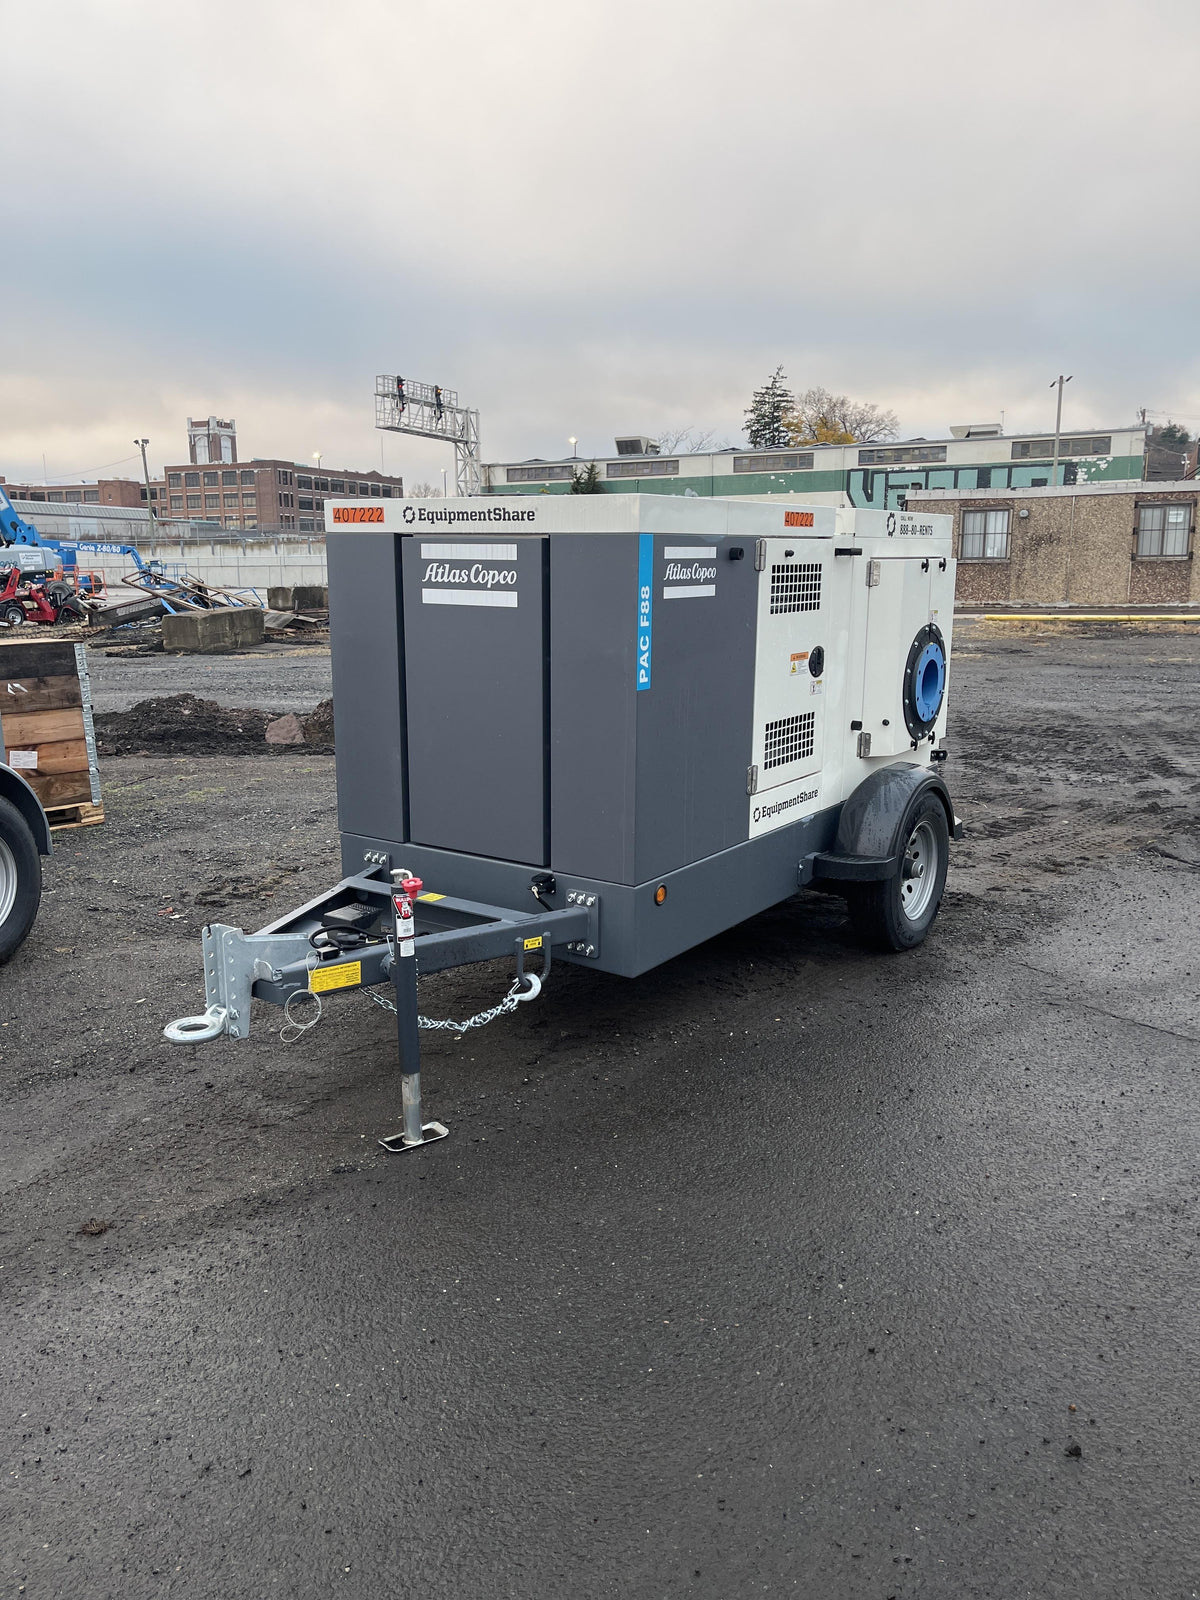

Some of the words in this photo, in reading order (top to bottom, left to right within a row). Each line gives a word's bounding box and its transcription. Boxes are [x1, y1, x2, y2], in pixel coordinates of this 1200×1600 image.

[333, 507, 384, 523] 407222
[418, 507, 536, 524] EquipmentShare
[784, 511, 814, 527] 407222
[79, 543, 96, 552] Genie
[422, 562, 468, 583] Atlas
[470, 563, 518, 588] Copco
[663, 562, 692, 581] Atlas
[692, 562, 717, 583] Copco
[640, 585, 651, 628] F88
[639, 635, 650, 684] PAC
[762, 789, 818, 817] EquipmentShare
